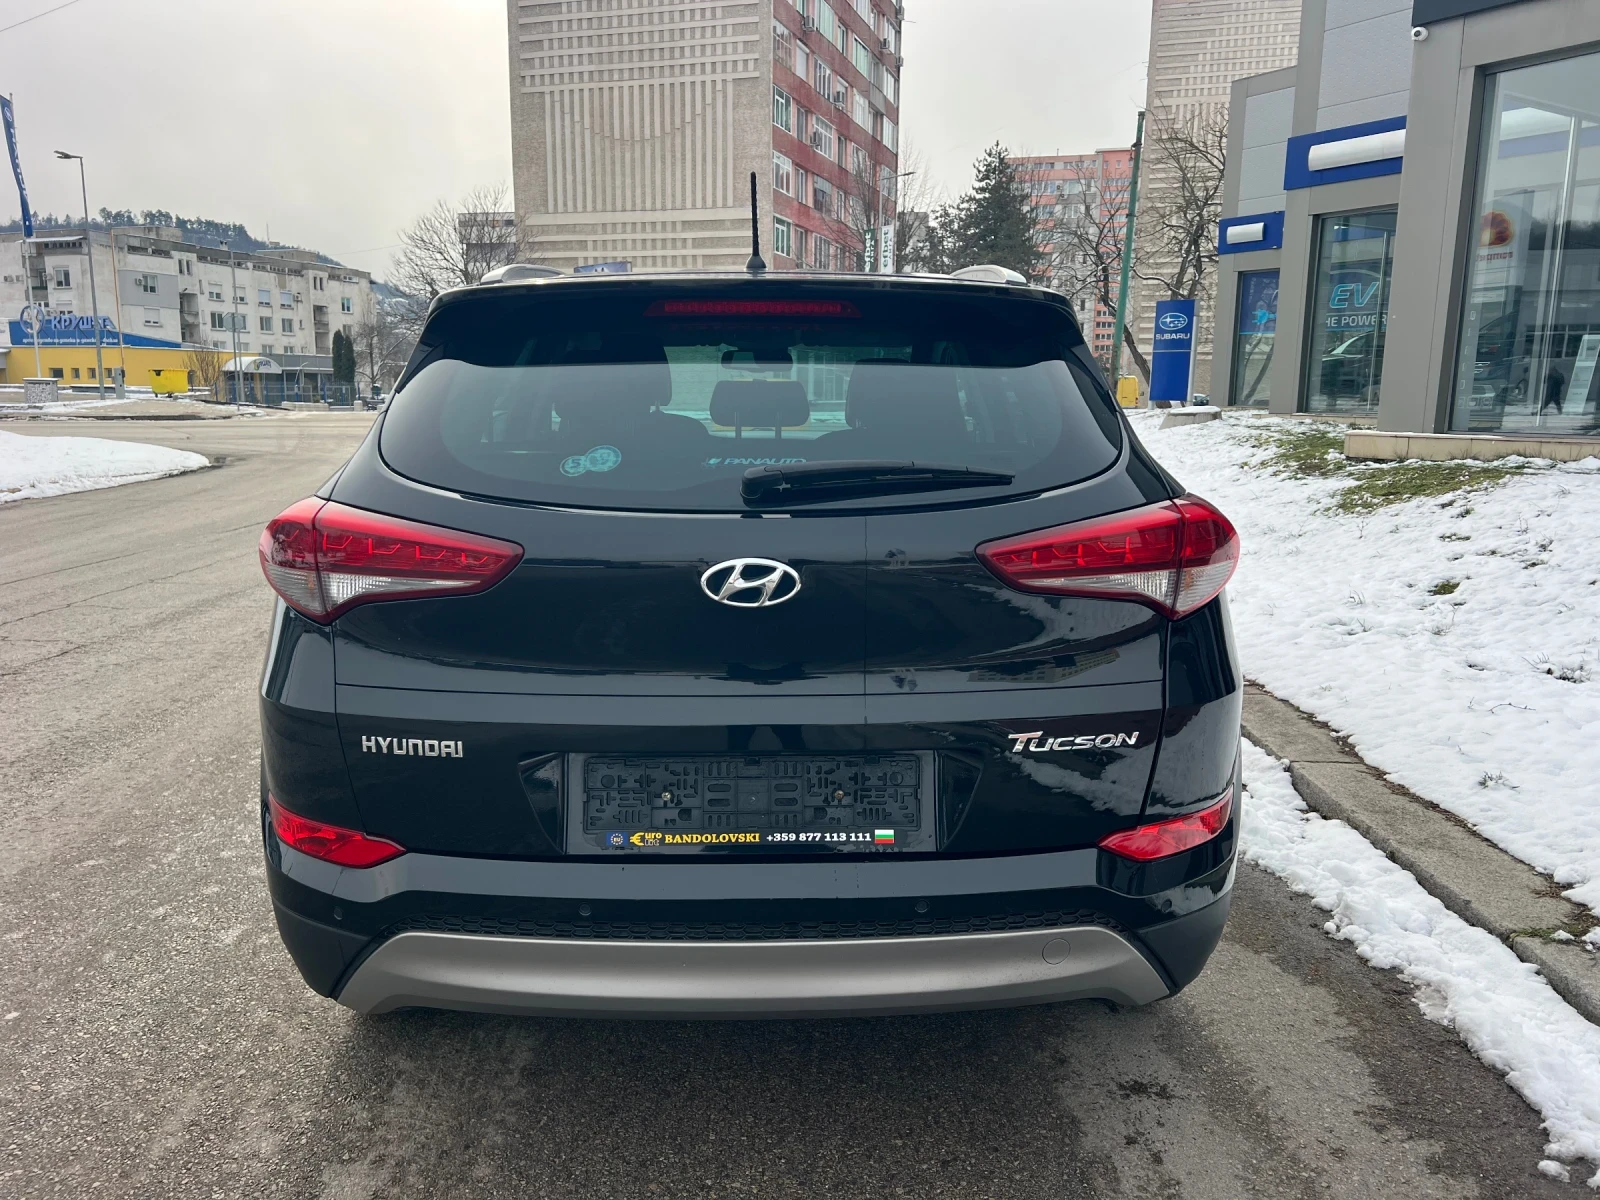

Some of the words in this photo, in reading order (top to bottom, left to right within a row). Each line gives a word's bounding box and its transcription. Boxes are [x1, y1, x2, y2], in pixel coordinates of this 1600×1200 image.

[1329, 281, 1380, 308] EV
[1155, 332, 1190, 340] SUBARU
[361, 735, 464, 758] HYUNDAI
[664, 833, 760, 844] BANDOLOVSKI
[766, 832, 797, 842] +359
[798, 832, 822, 842] 877
[824, 832, 847, 842] 113
[849, 832, 871, 842] 111
